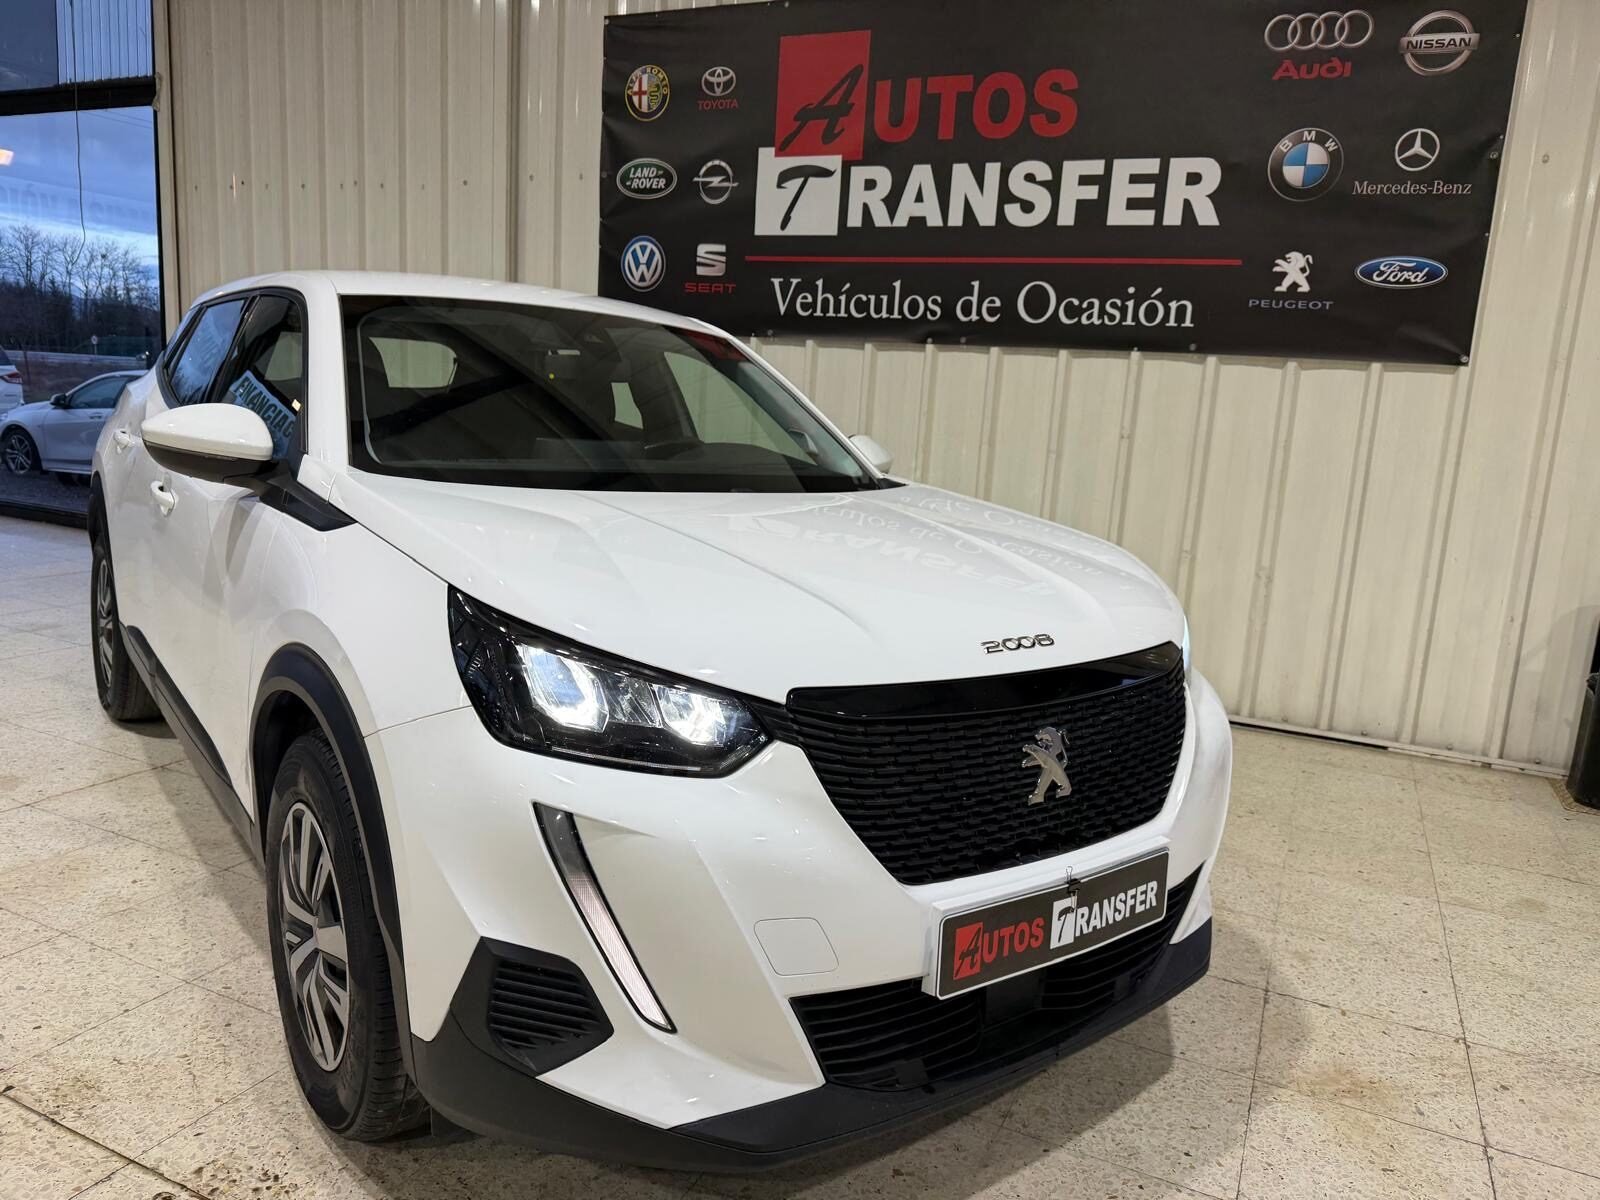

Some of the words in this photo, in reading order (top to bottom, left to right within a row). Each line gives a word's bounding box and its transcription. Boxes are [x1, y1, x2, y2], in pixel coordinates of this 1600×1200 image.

[1406, 37, 1472, 50] NISSAN
[1272, 57, 1352, 80] Audi
[698, 99, 739, 111] TOYOTA
[776, 62, 1079, 152] AUTOS
[1280, 131, 1338, 152] BMW
[629, 167, 657, 178] LAND
[631, 178, 666, 189] ROVER
[774, 157, 1222, 231] TRANSFER
[1352, 180, 1472, 196] Mercedes-Benz
[1373, 260, 1428, 285] Ford
[685, 282, 736, 293] SEAT
[770, 278, 942, 320] Vehículos
[955, 280, 1001, 322] de
[1017, 280, 1194, 328] Ocasión
[1249, 299, 1334, 310] PEUGEOT
[980, 633, 1055, 654] 2008
[954, 917, 1046, 976] AUTOS
[1051, 880, 1158, 944] TRANSFER
